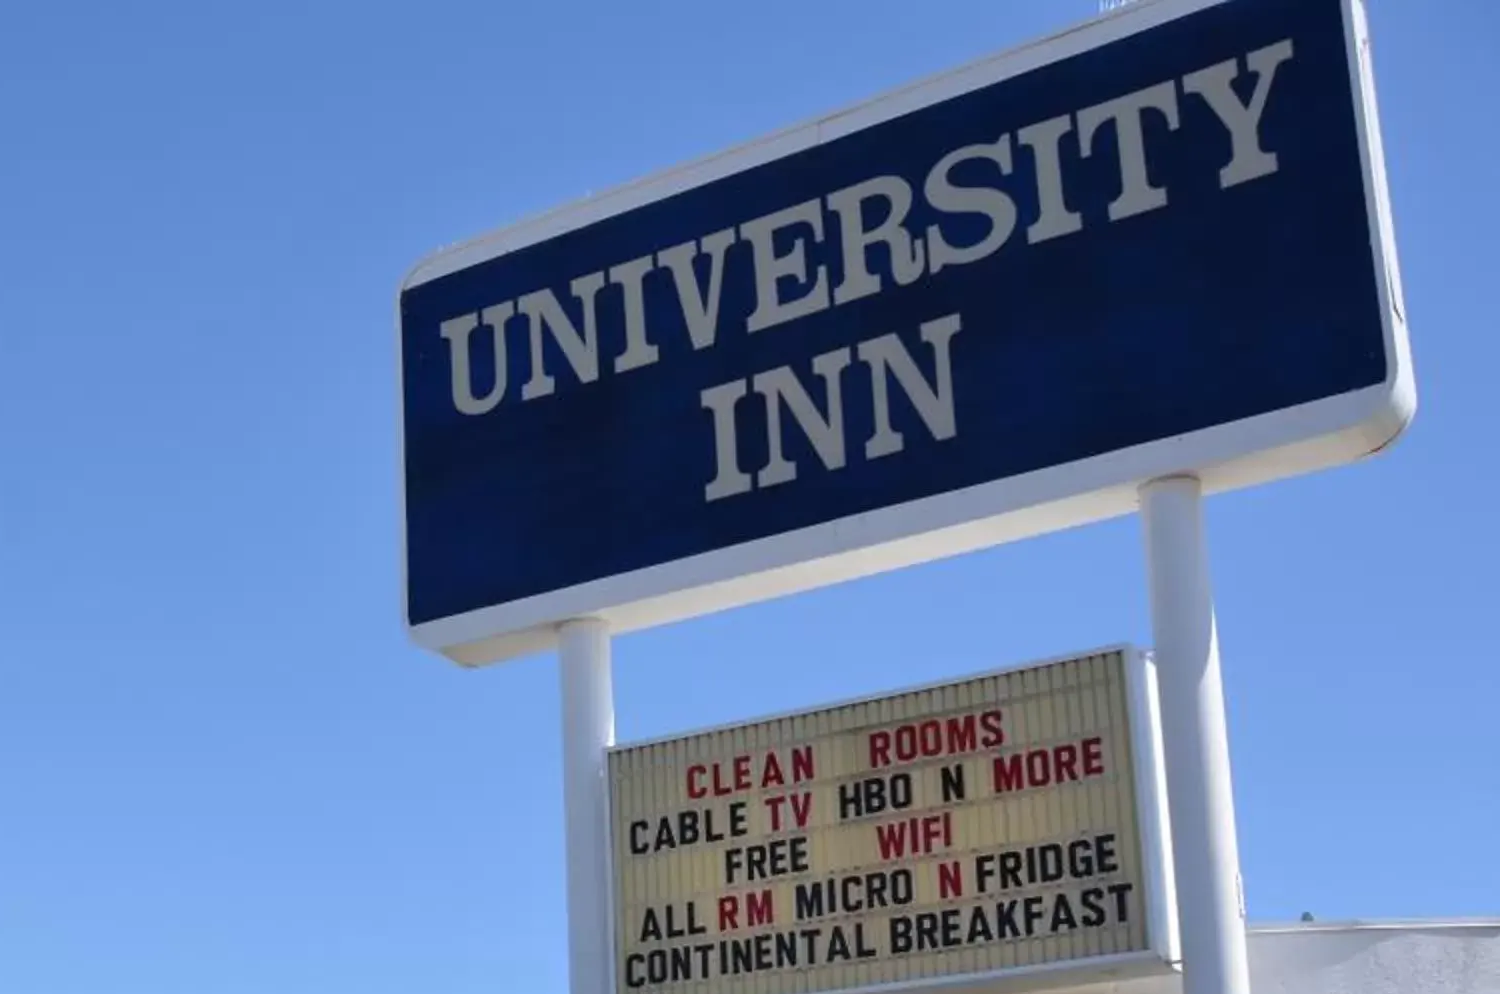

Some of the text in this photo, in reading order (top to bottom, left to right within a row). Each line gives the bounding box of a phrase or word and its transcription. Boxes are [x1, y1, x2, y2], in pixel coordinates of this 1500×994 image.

[440, 38, 1294, 416] UNIVERSITY
[700, 312, 962, 503] INN
[629, 737, 1104, 855] CABLE TV HBO N MORE
[686, 710, 1004, 799] CLEAN ROOMS
[640, 833, 1118, 943] ALL RM MICRO N FRIDGE
[725, 812, 951, 884] FREE WIFI
[625, 883, 1133, 988] CONTINENTAL BREAKFAST
